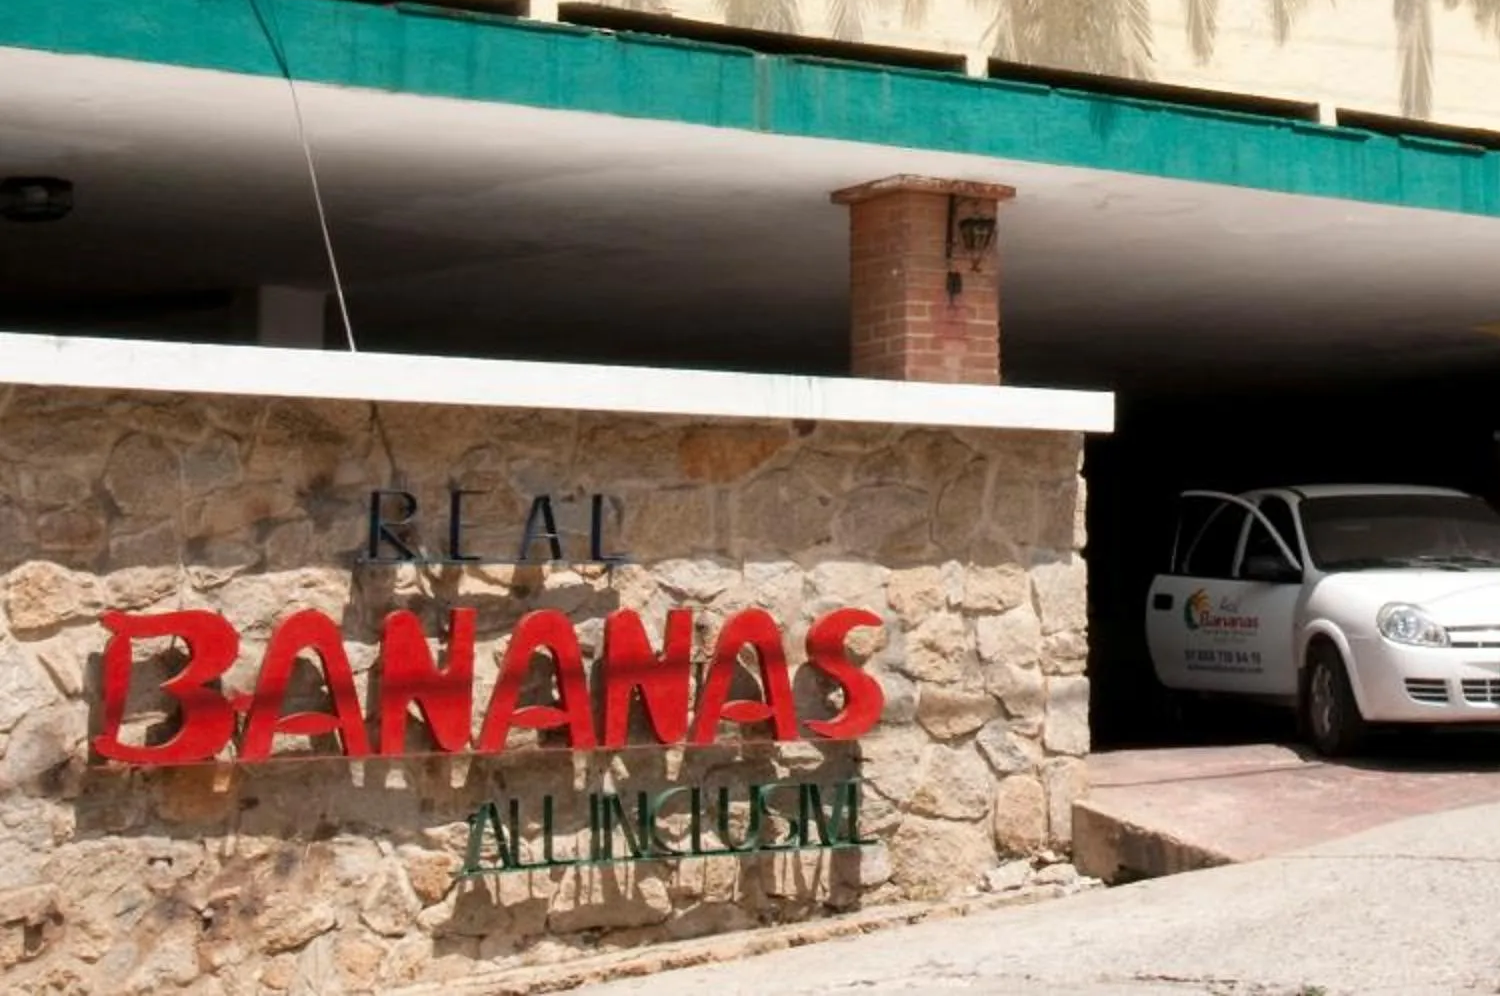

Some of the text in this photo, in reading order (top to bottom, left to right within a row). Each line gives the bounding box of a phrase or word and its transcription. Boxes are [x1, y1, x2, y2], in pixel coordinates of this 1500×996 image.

[367, 489, 630, 562] REAL
[1199, 609, 1259, 628] Bananas
[94, 607, 886, 764] BANANAS
